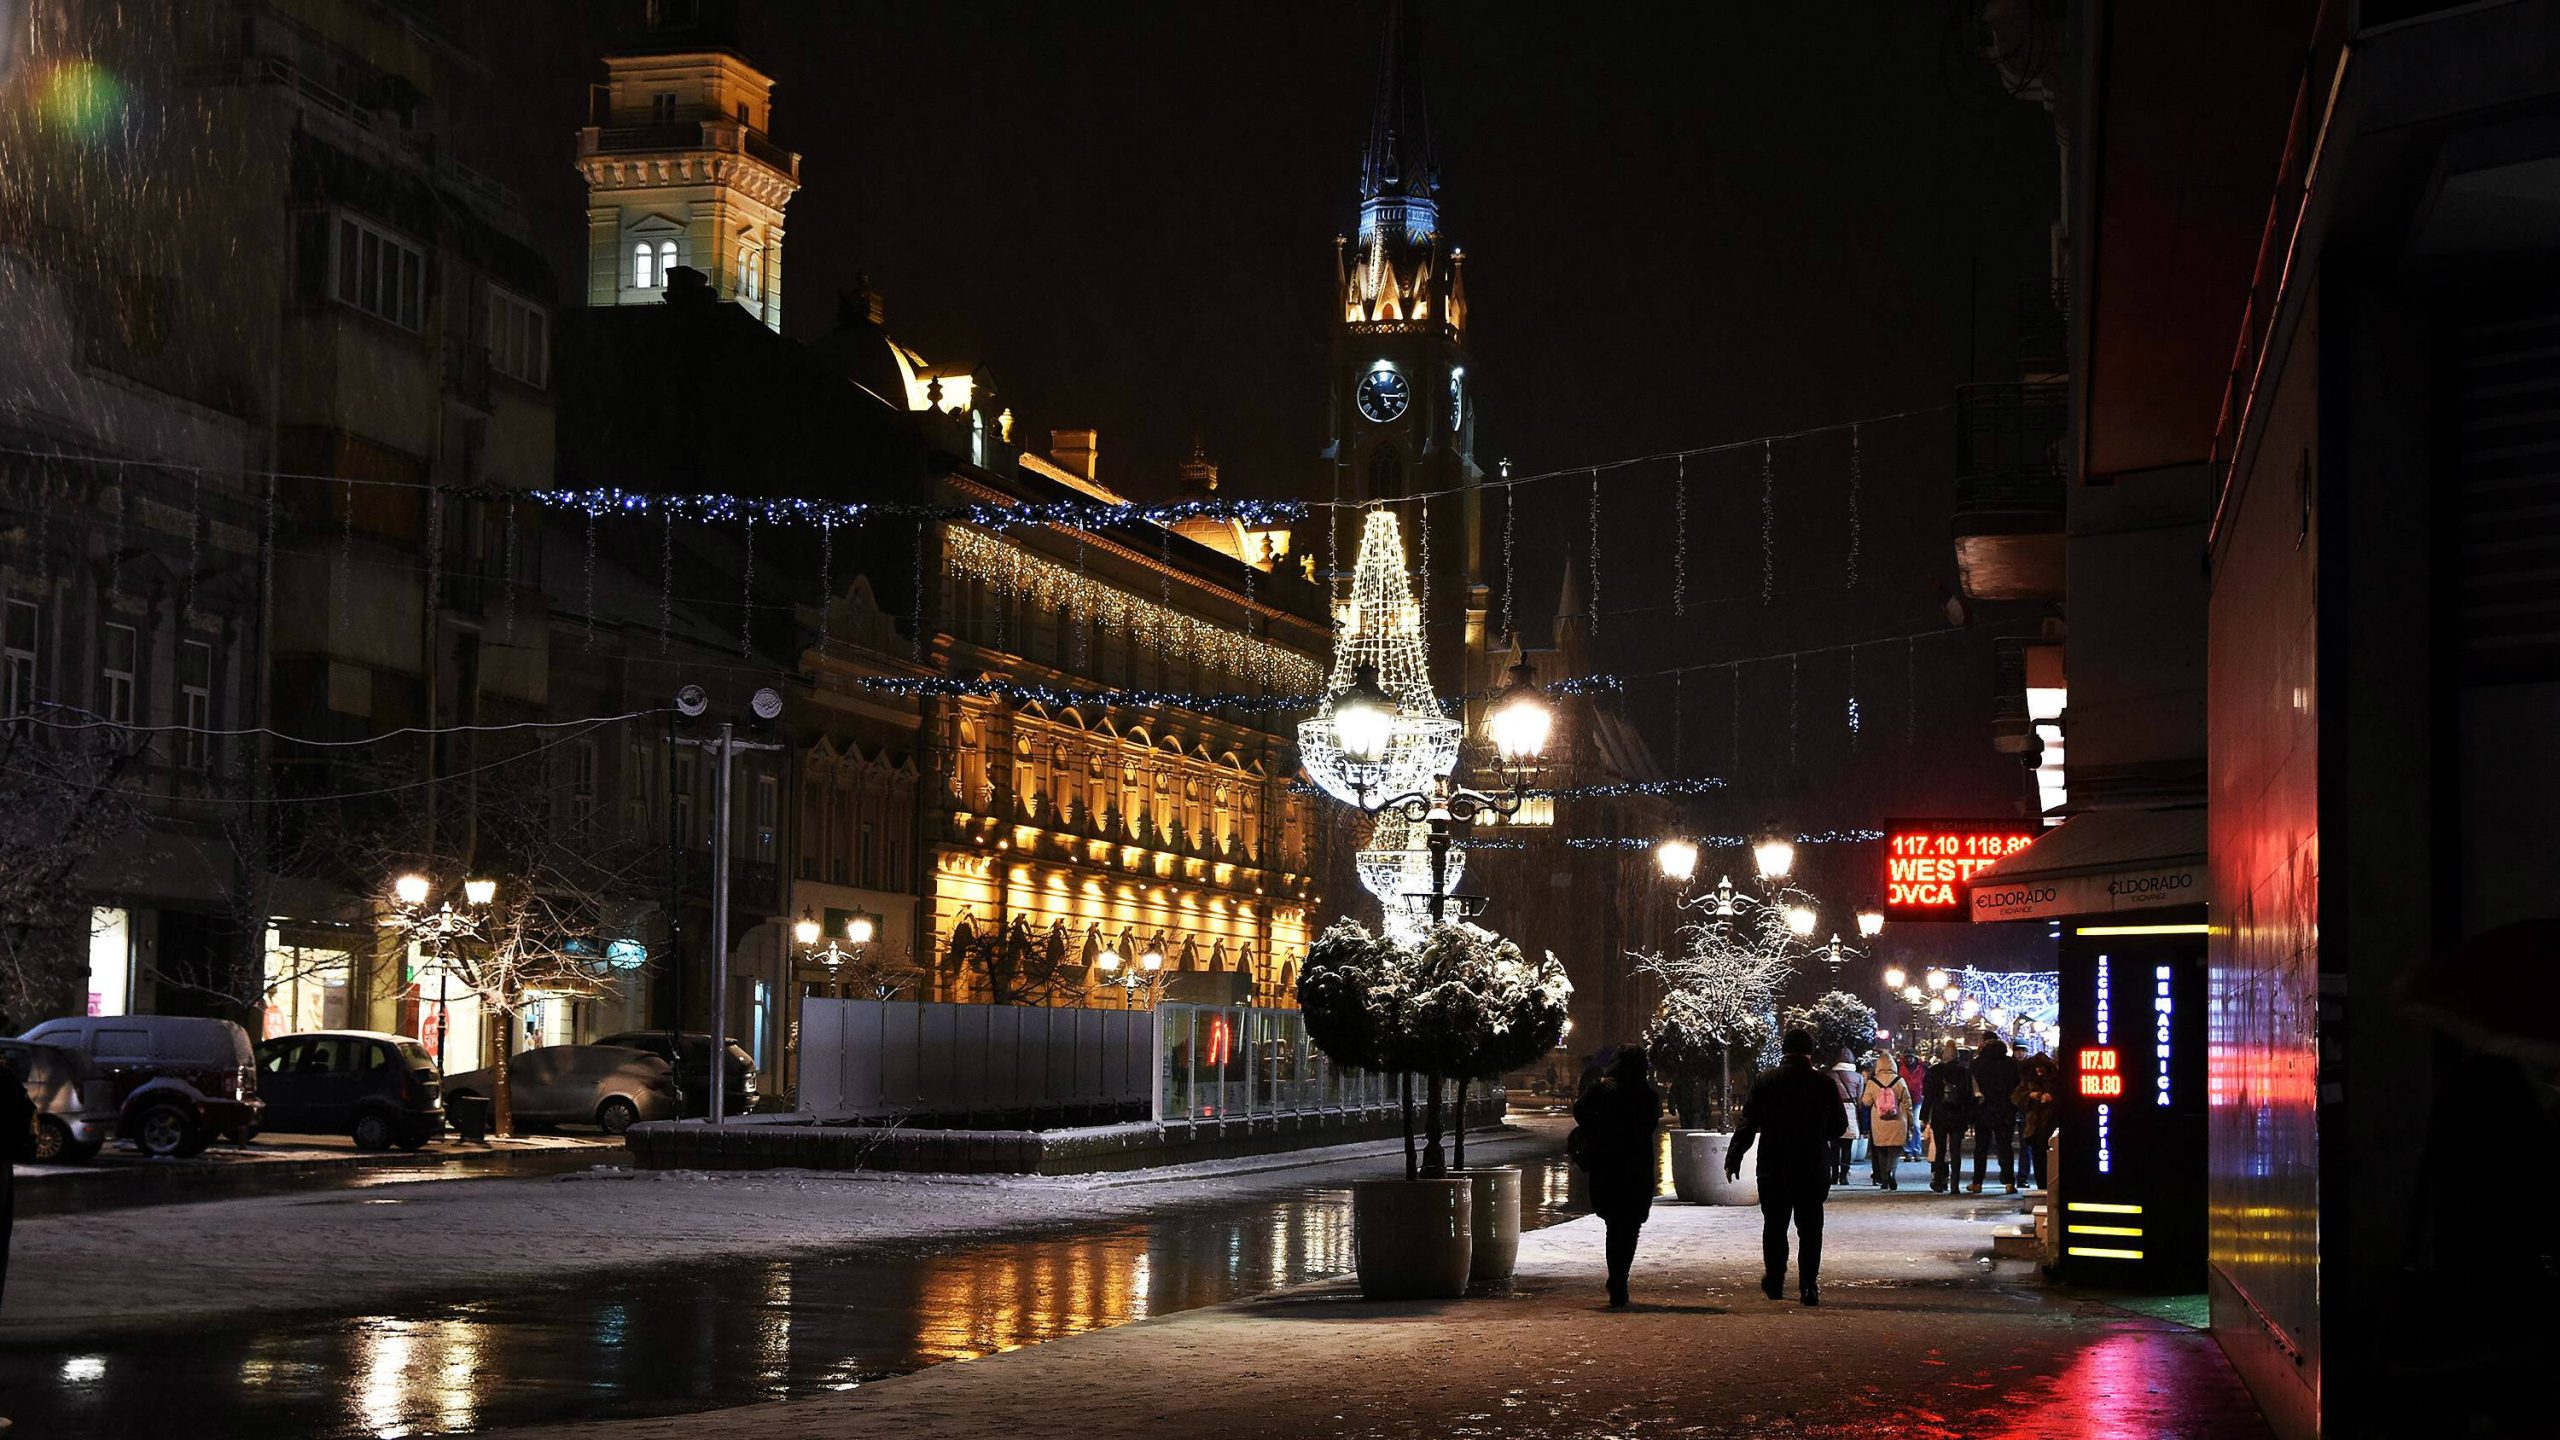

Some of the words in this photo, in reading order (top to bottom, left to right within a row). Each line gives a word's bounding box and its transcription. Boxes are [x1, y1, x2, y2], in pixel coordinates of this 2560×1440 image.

[1892, 836, 1959, 855] 117.10
[2131, 892, 2167, 903] EXCHANGE
[2000, 906, 2033, 916] EXCHANGE
[2097, 954, 2109, 1044] EXCHANGE
[2080, 1050, 2116, 1070] 117.10
[2080, 1075, 2121, 1095] 118.80
[2098, 1103, 2109, 1172] OFFICE
